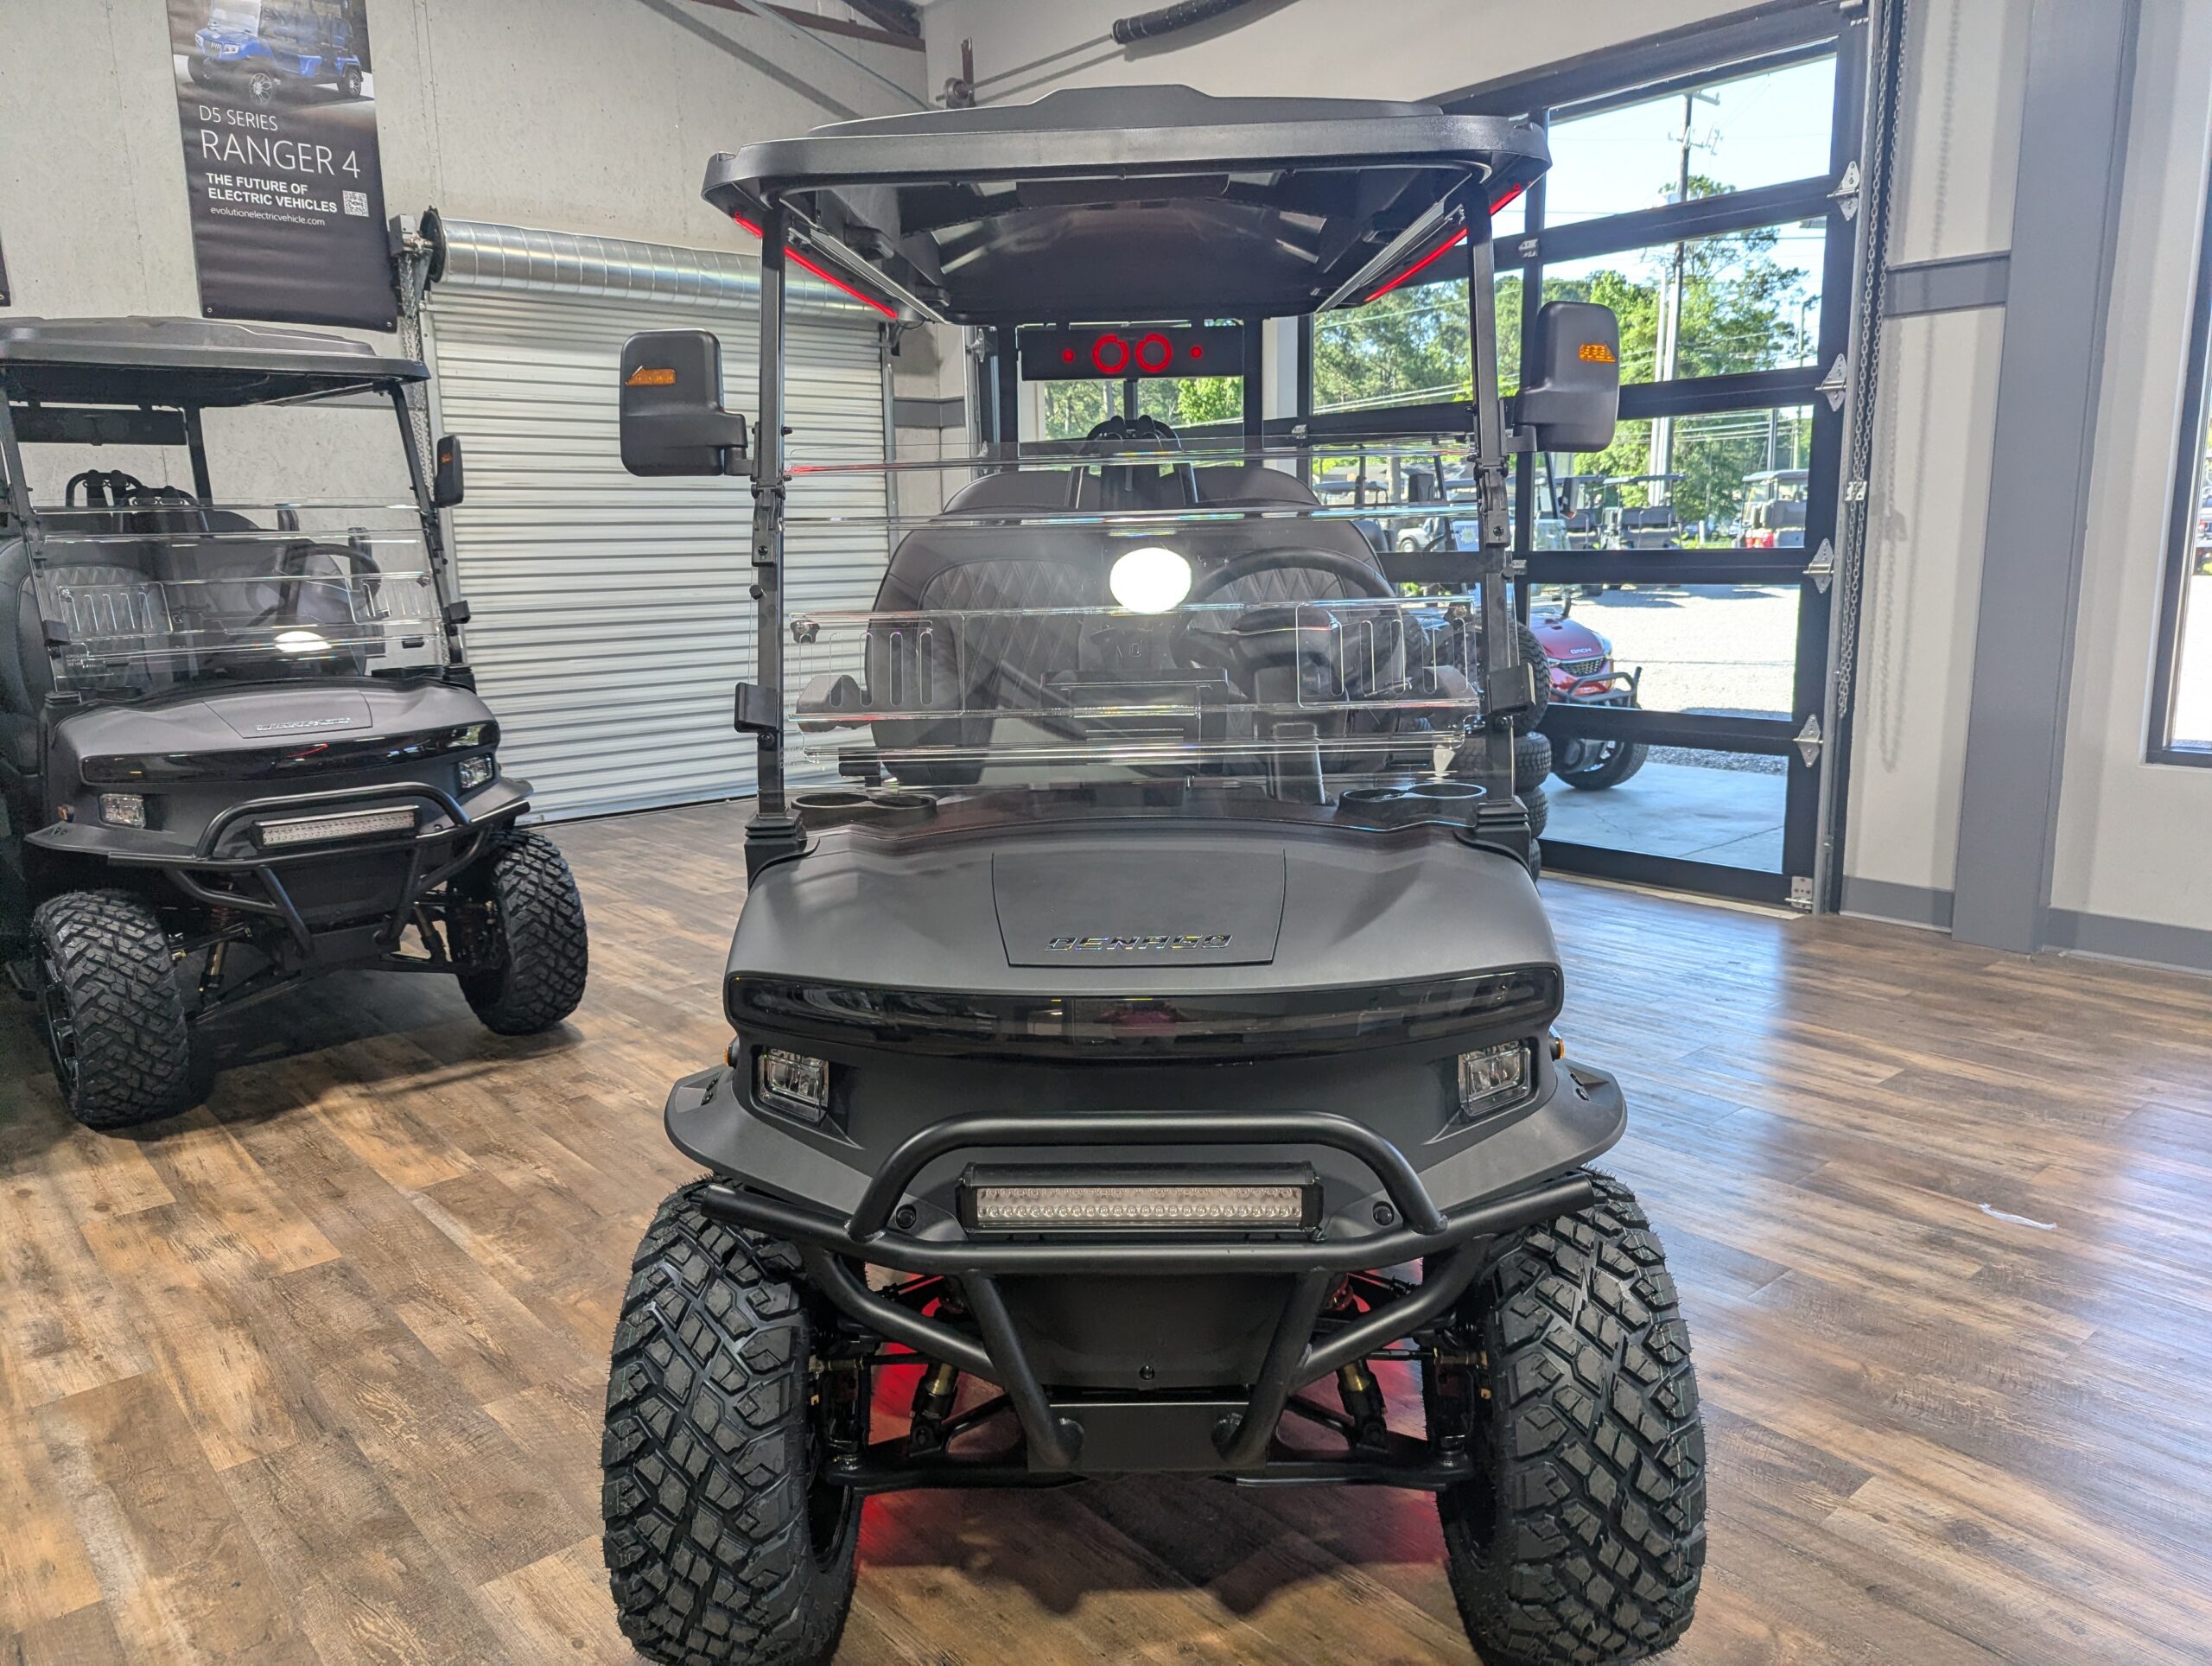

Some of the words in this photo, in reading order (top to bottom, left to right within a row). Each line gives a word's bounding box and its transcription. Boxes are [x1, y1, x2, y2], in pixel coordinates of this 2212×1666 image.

[199, 105, 221, 123] D5
[227, 109, 278, 131] SERIES
[200, 129, 335, 176] RANGER
[341, 149, 361, 179] 4
[206, 172, 233, 187] THE
[236, 176, 288, 193] FUTURE
[290, 183, 308, 195] OF
[207, 188, 273, 206] ELECTRIC
[276, 195, 338, 213] VEHICLES
[210, 206, 326, 226] evolutionelectricvehicle.com
[1044, 934, 1233, 951] DENAGO
